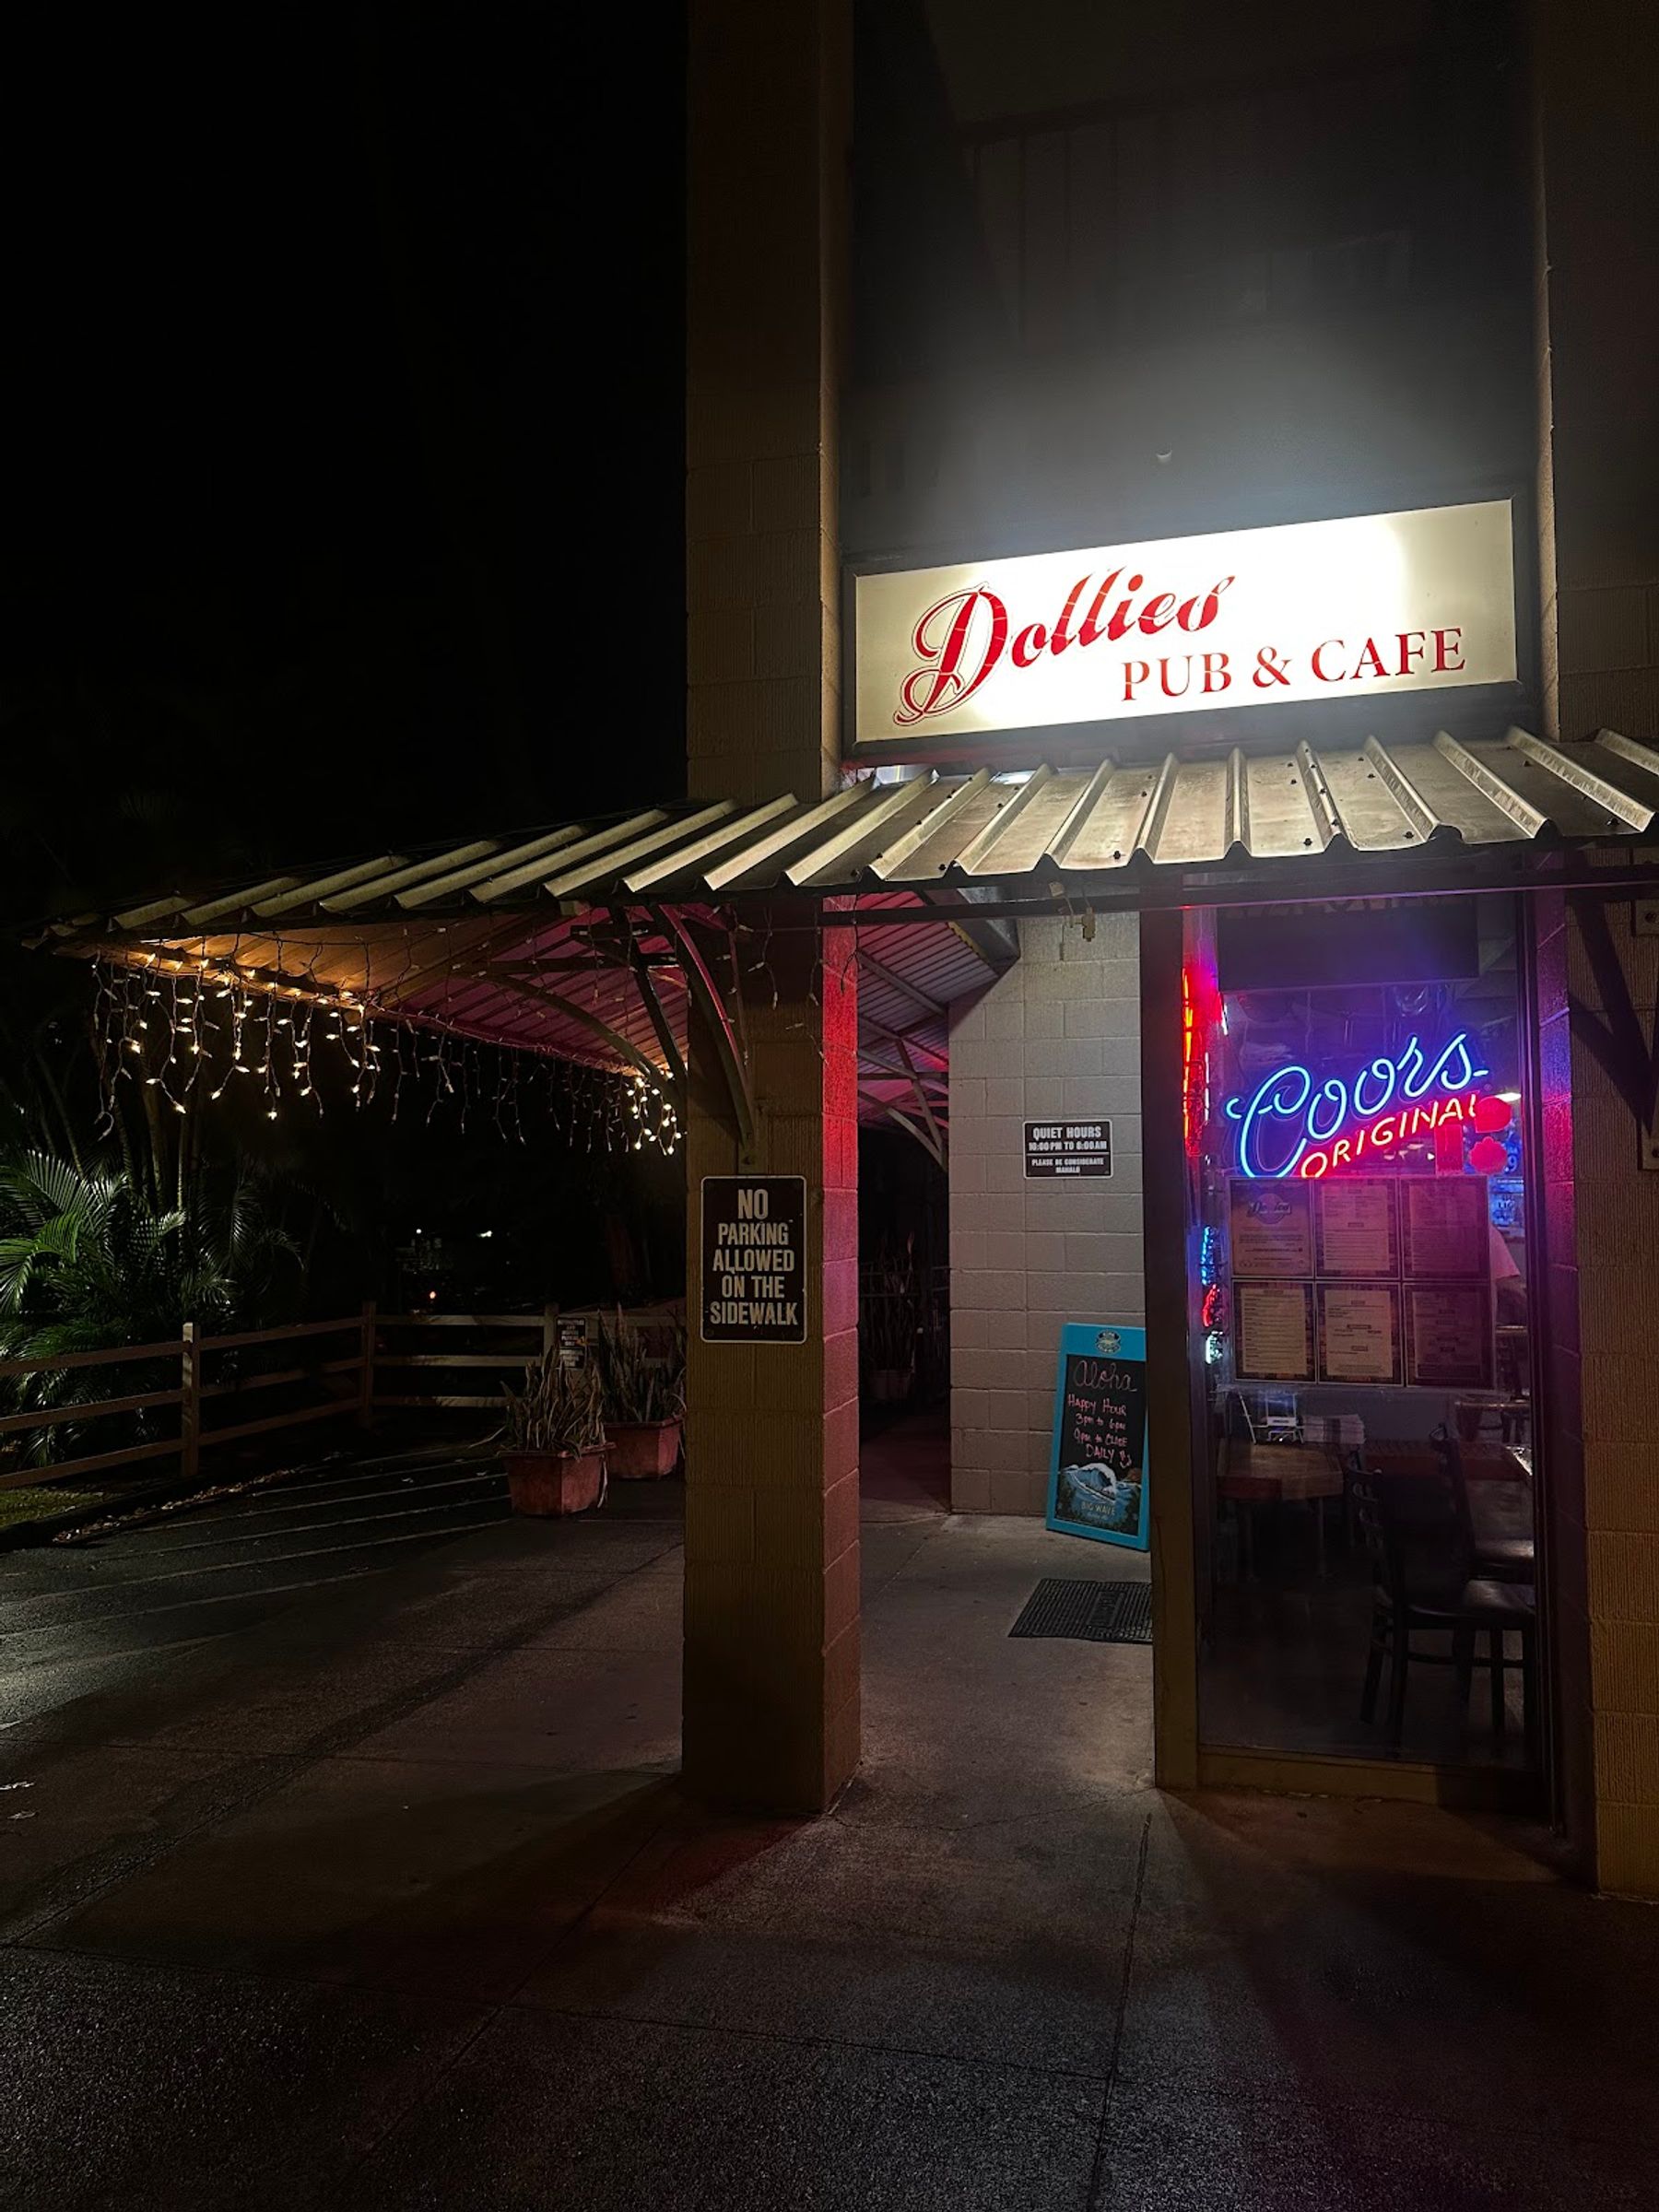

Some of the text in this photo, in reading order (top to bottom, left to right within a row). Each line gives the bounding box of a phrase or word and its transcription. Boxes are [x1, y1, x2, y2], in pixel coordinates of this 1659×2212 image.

[1121, 628, 1466, 702] PUB & CAFE
[1226, 1033, 1488, 1178] Coors
[1032, 1126, 1101, 1141] QUIET HOURS
[1064, 1141, 1075, 1150] TO
[1031, 1159, 1053, 1167] PLEASE
[1054, 1158, 1063, 1166] BE
[737, 1189, 769, 1219] NO
[718, 1222, 789, 1245] PARKING
[712, 1249, 794, 1272] ALLOWED
[722, 1276, 785, 1299] ON THE
[710, 1301, 798, 1325] SIDEWALK
[1073, 1359, 1137, 1393] Aloha
[1086, 1443, 1114, 1464] DAILY
